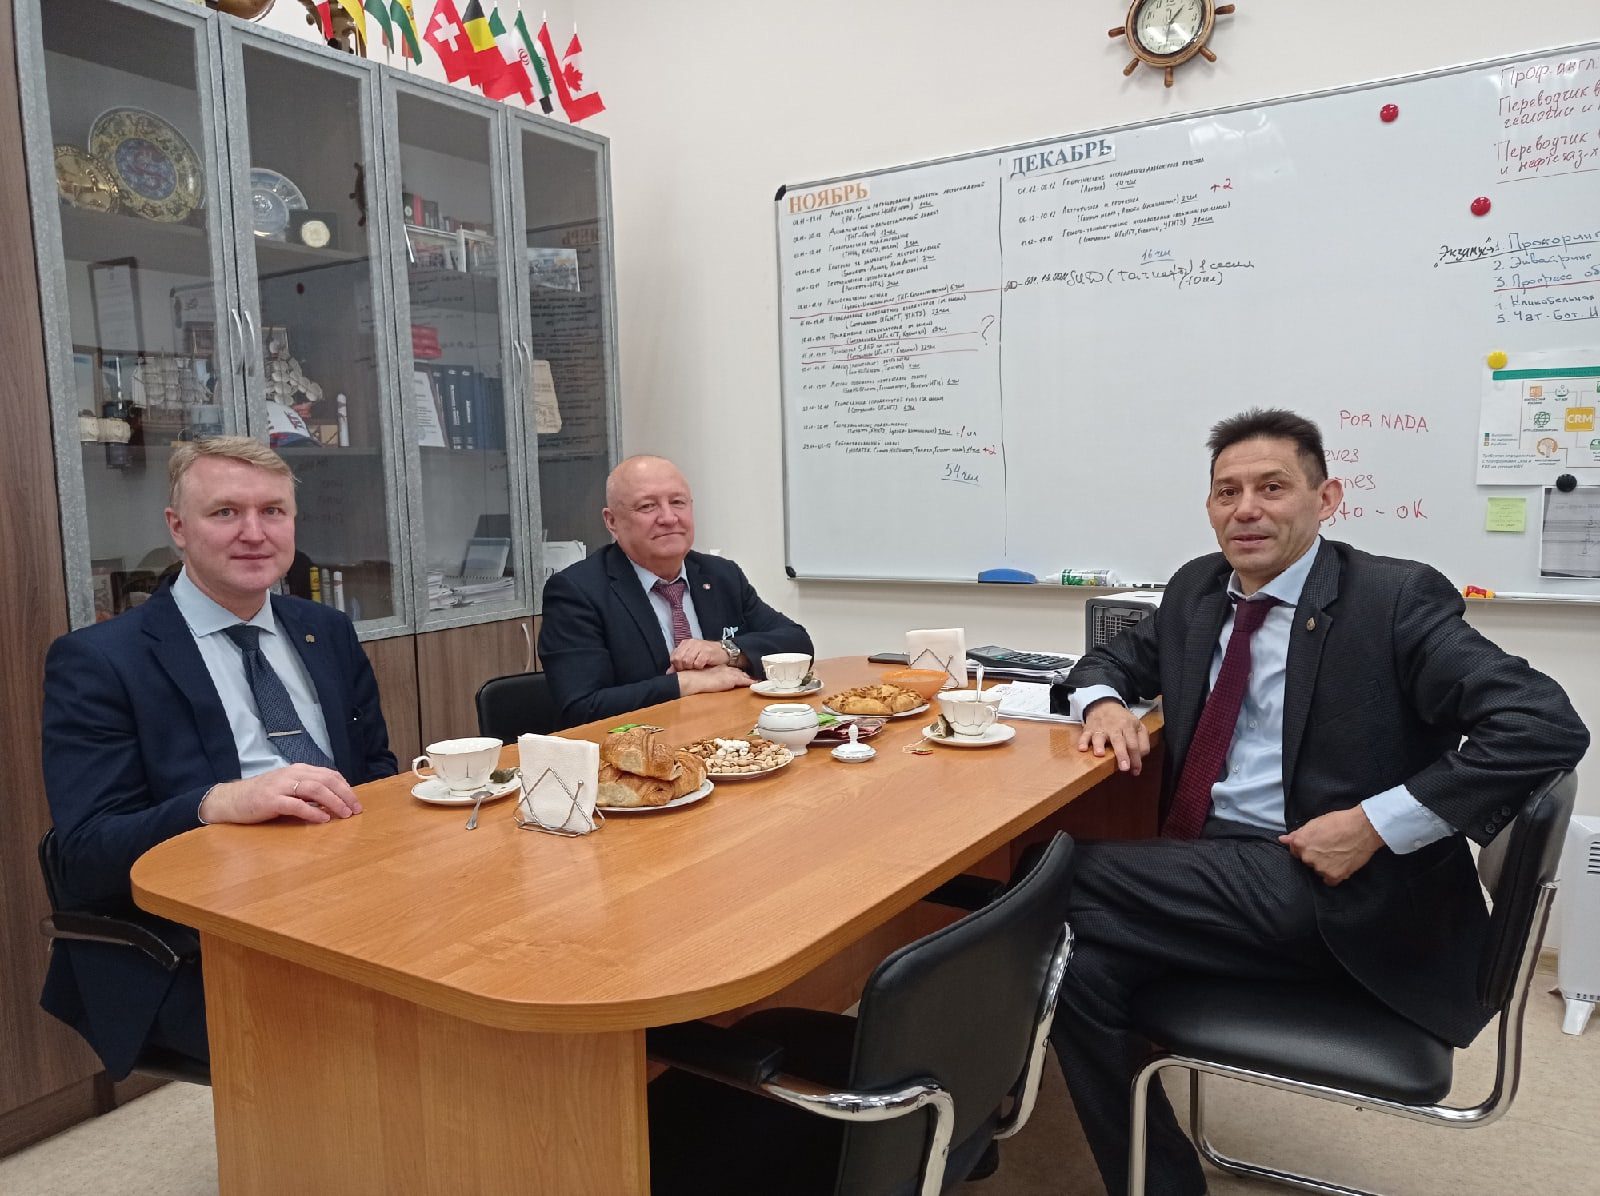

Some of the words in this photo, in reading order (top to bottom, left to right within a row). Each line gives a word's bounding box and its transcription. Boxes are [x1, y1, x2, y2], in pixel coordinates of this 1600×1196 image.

[1010, 139, 1113, 179] ДЕКАБРЬ
[789, 182, 868, 213] НОЯБРЬ
[1380, 413, 1430, 433] NADA
[1566, 413, 1593, 424] CRM
